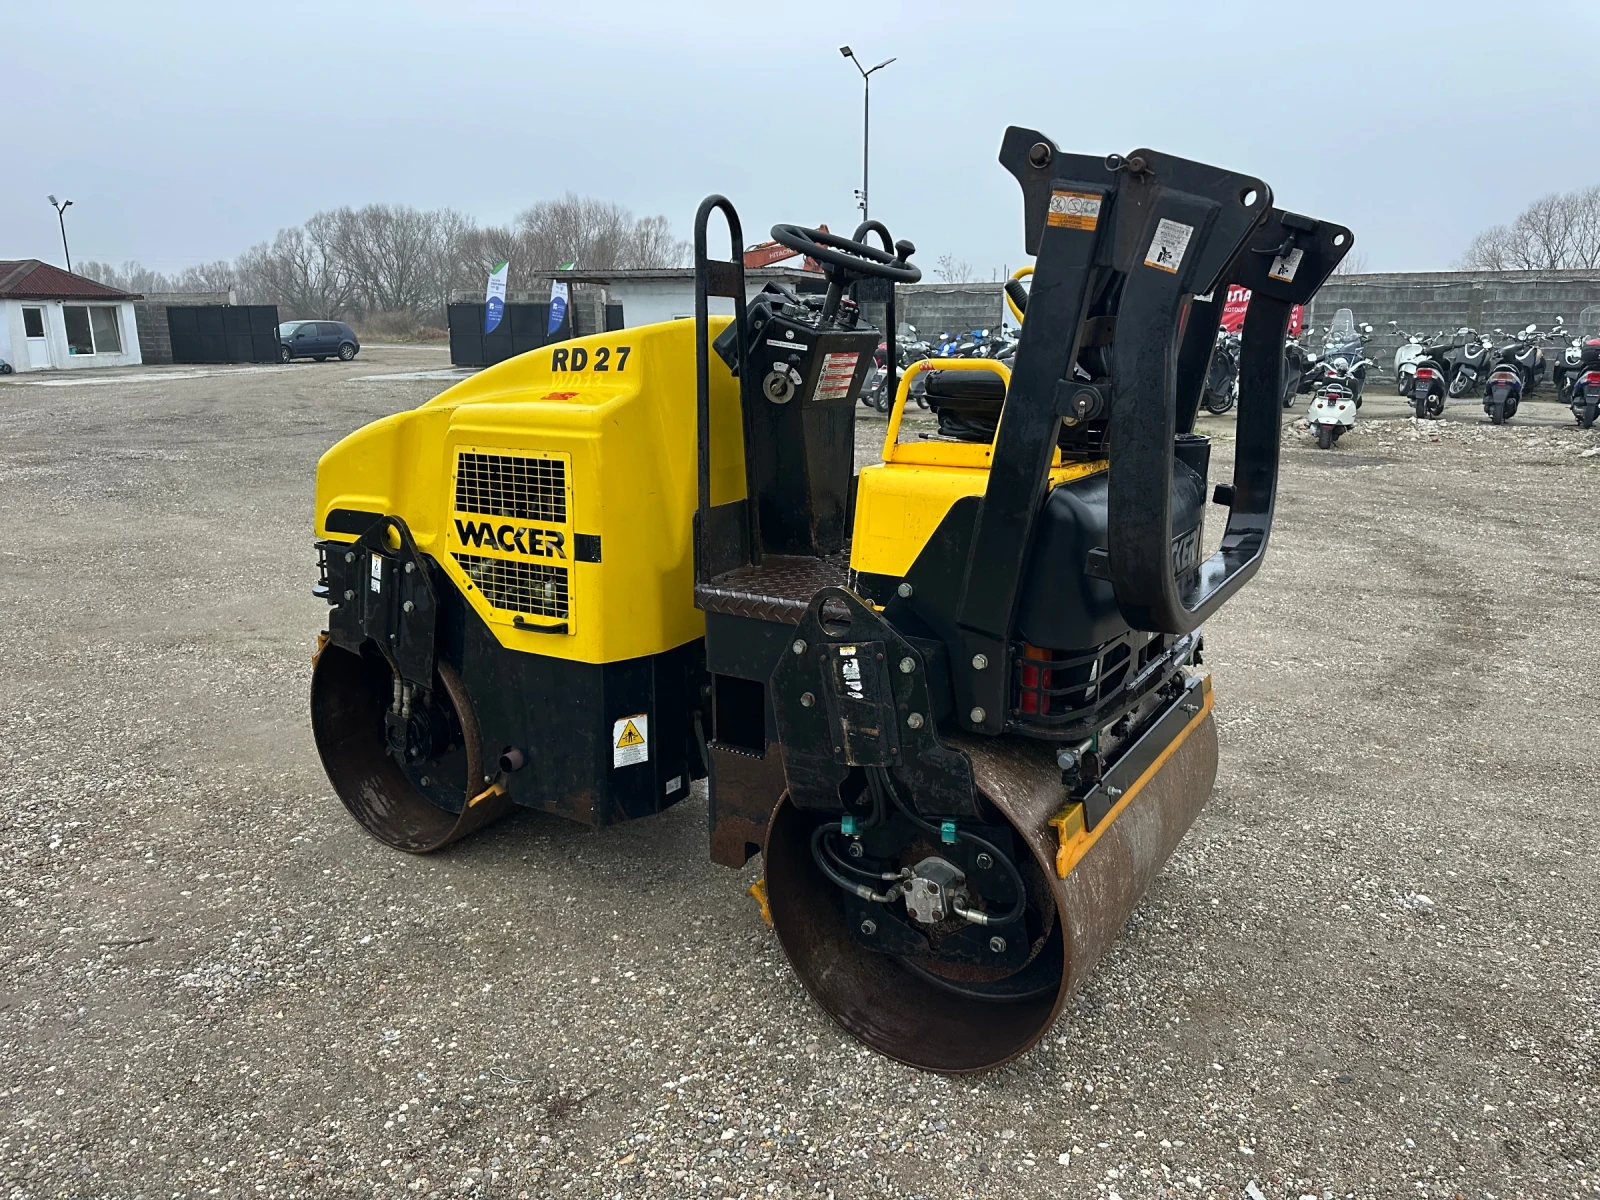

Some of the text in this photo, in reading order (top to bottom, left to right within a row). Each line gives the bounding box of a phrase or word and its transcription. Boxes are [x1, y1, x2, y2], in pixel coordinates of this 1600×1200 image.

[551, 346, 631, 372] RD 27
[454, 518, 567, 559] WACKER
